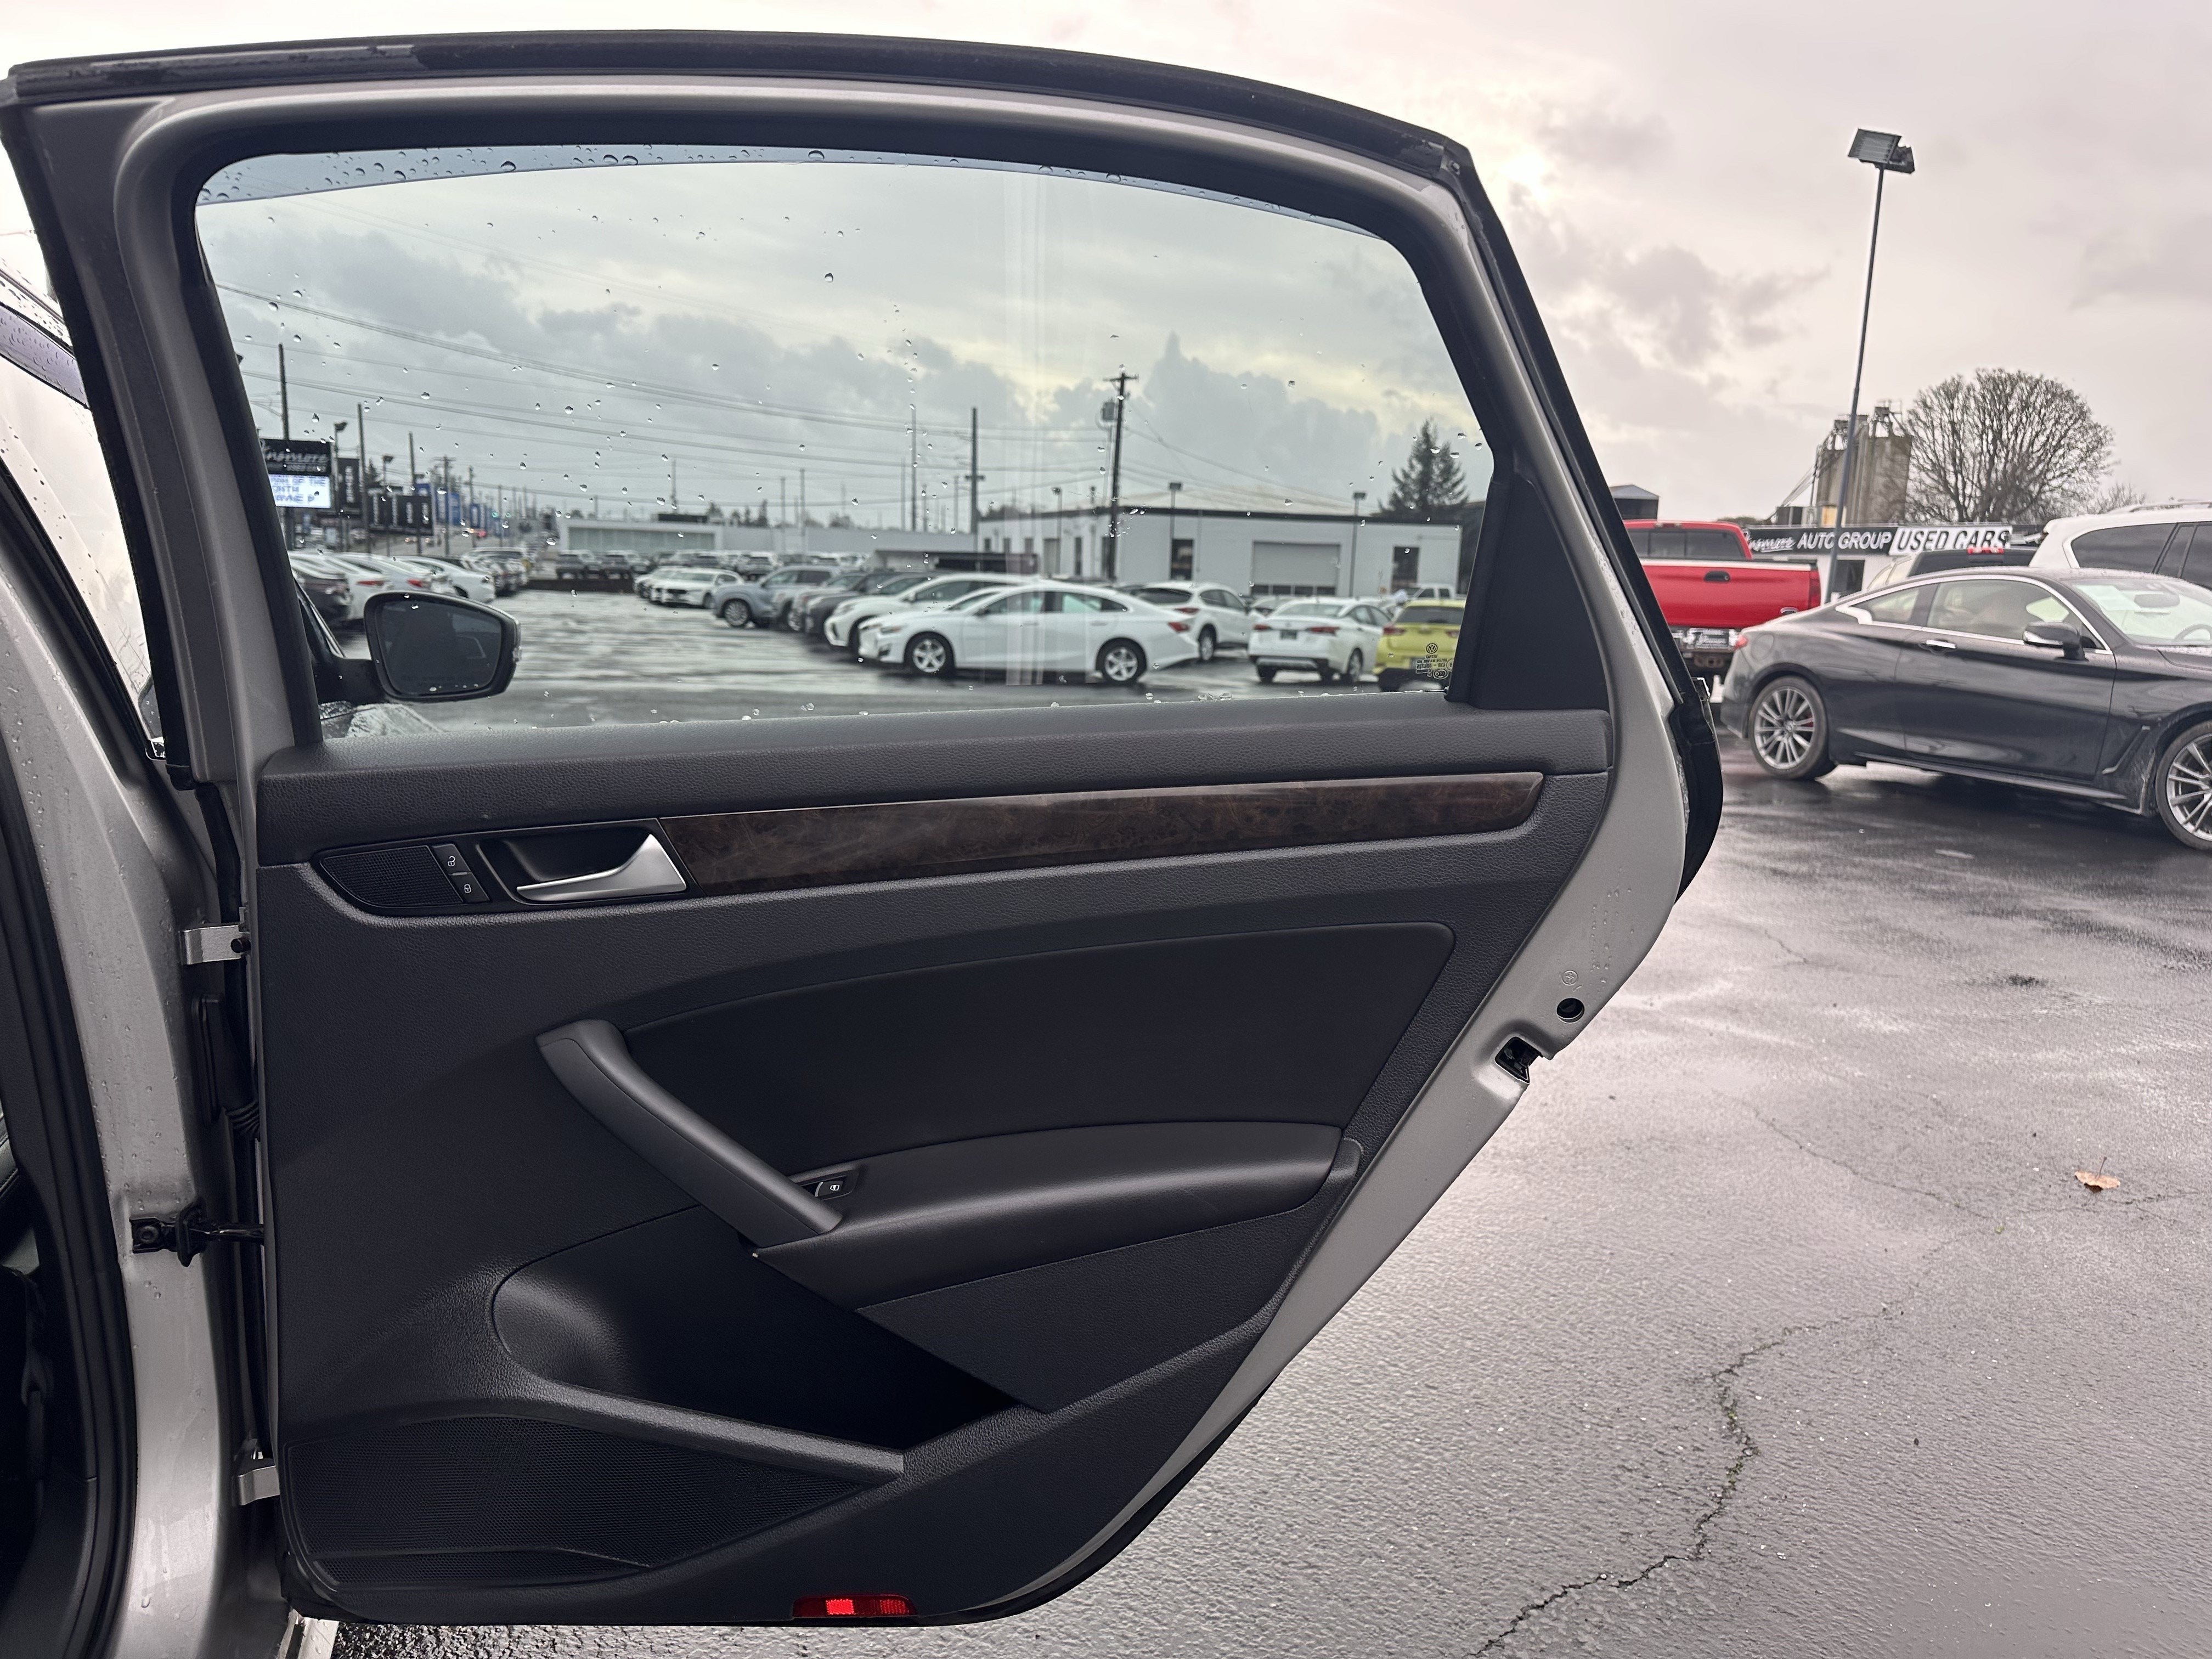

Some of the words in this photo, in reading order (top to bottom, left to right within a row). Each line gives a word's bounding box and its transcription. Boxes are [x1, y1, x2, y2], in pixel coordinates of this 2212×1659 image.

[1797, 532, 1836, 549] AUTO
[1838, 531, 1892, 550] GROUP
[1897, 530, 1949, 551] USED
[1954, 530, 2011, 550] CARS
